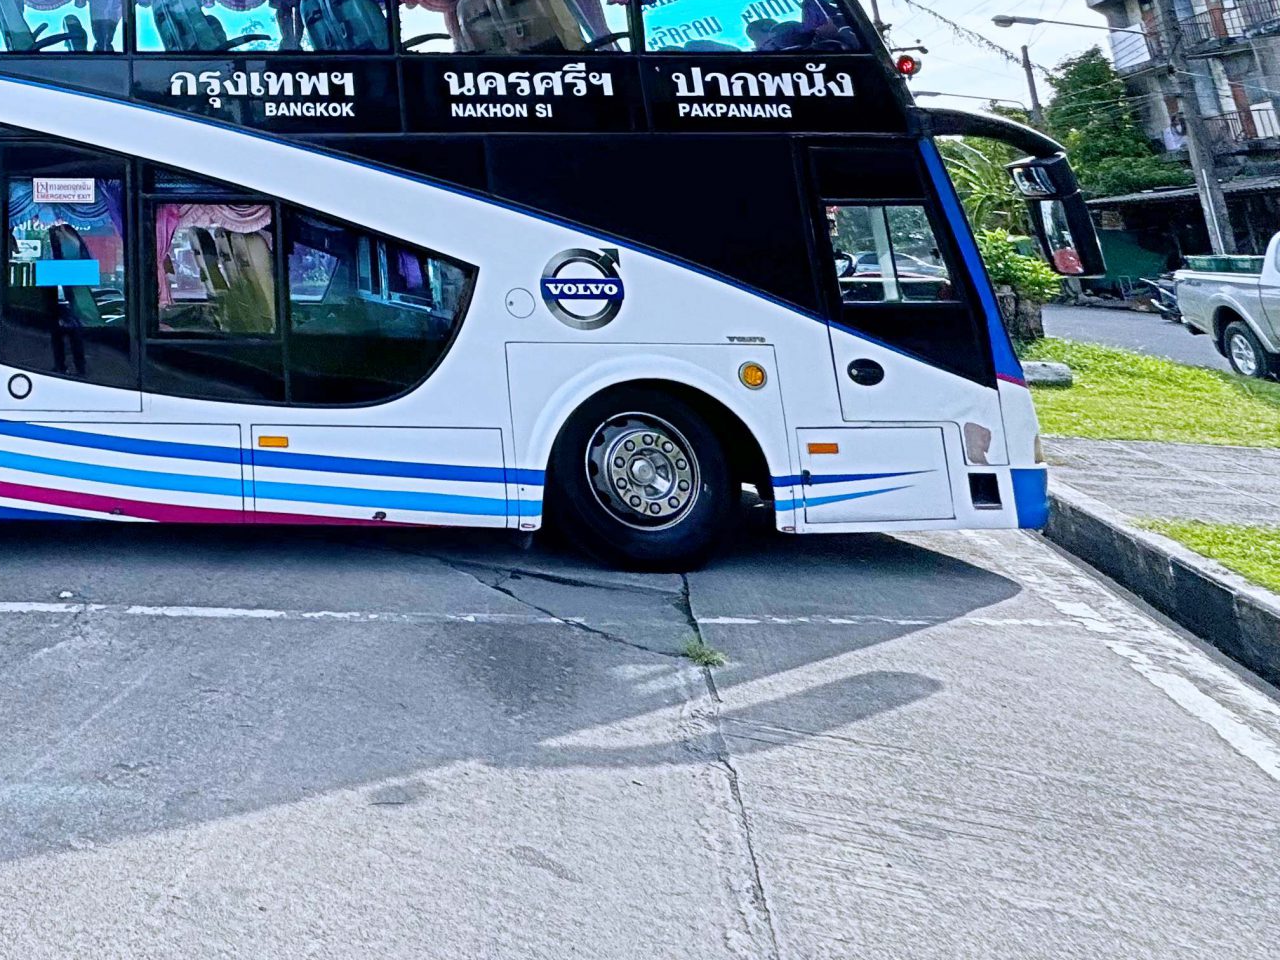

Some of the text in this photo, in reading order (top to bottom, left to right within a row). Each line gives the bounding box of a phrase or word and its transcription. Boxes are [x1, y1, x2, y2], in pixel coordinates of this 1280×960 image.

[443, 62, 614, 96] นครศรีฯ
[671, 63, 855, 97] ปากพนัง
[170, 71, 355, 108] กรุงเทพฯ
[265, 102, 355, 117] BANGKOK
[451, 103, 553, 118] NAKHON SI
[678, 103, 793, 118] PAKPANANG
[545, 283, 618, 295] VOLVO
